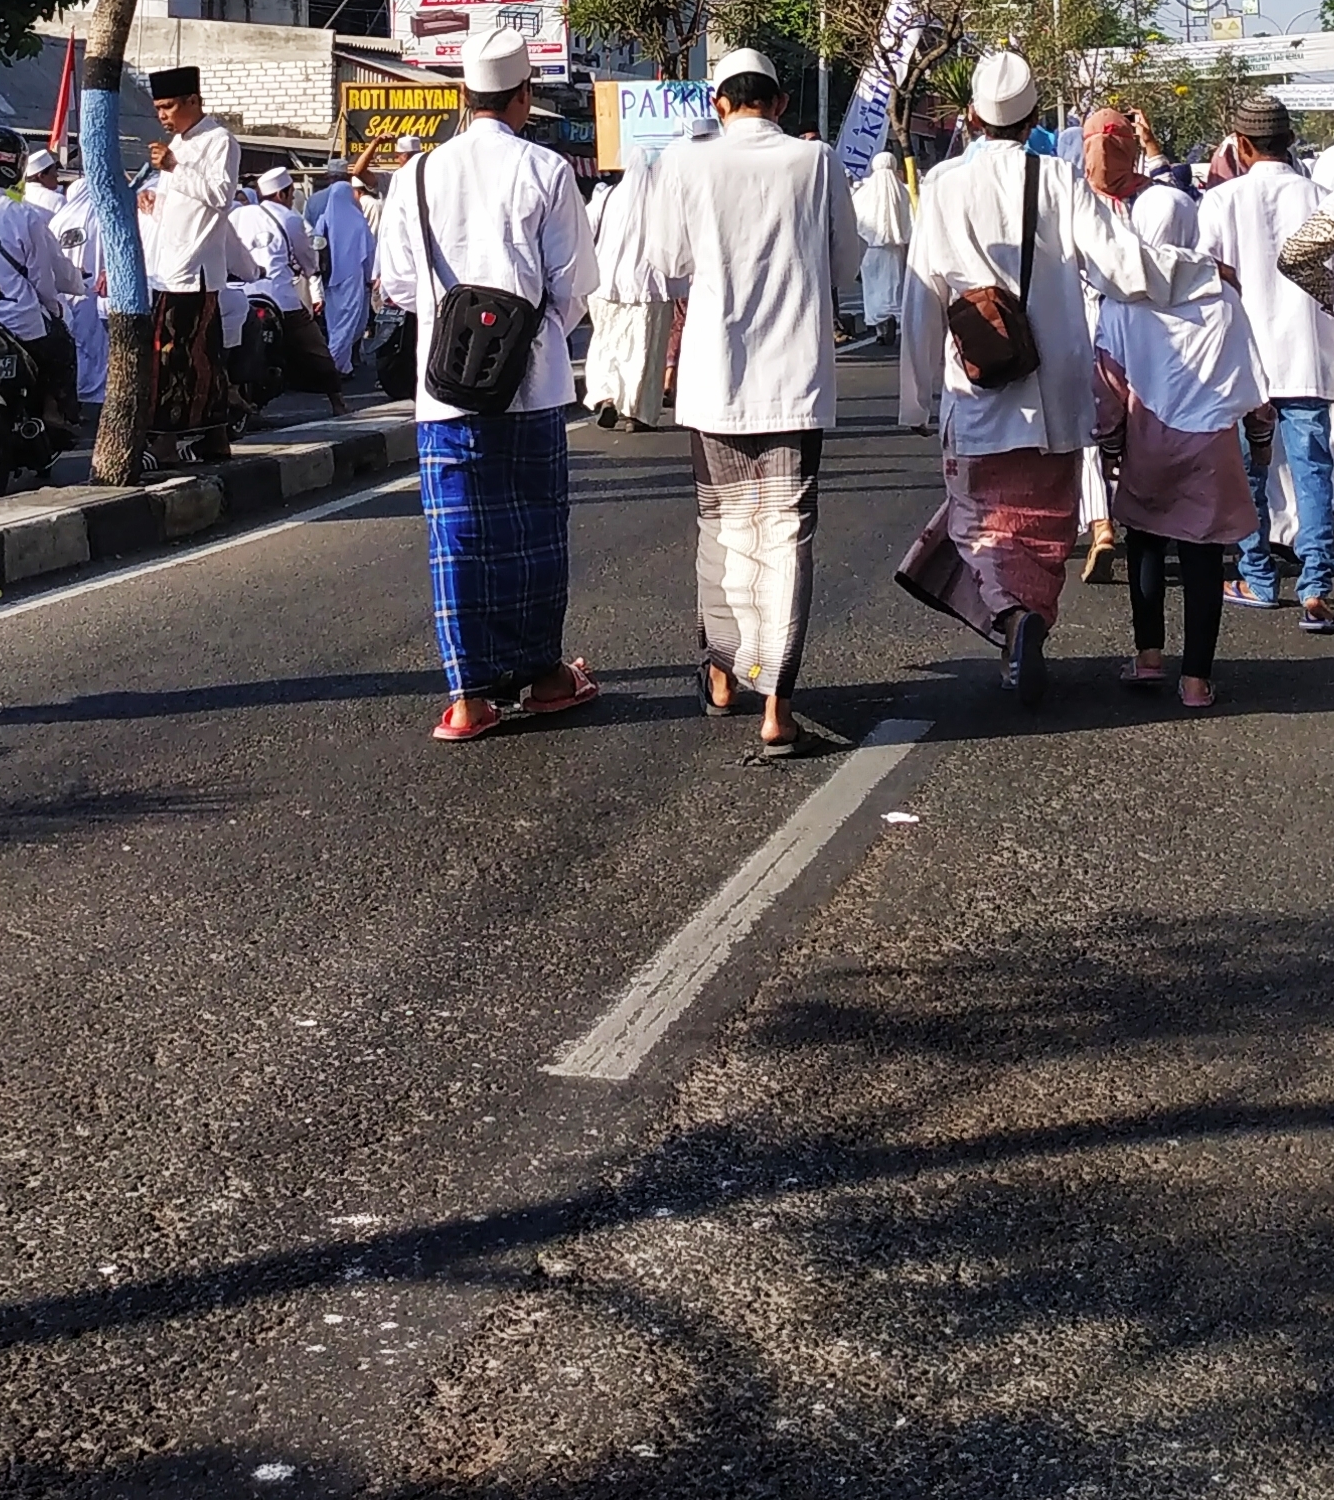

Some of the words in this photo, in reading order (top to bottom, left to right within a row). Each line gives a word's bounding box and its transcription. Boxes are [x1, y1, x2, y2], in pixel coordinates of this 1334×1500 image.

[348, 89, 385, 110] ROTI
[389, 89, 458, 110] MARYAM
[365, 112, 441, 137] SALMAN
